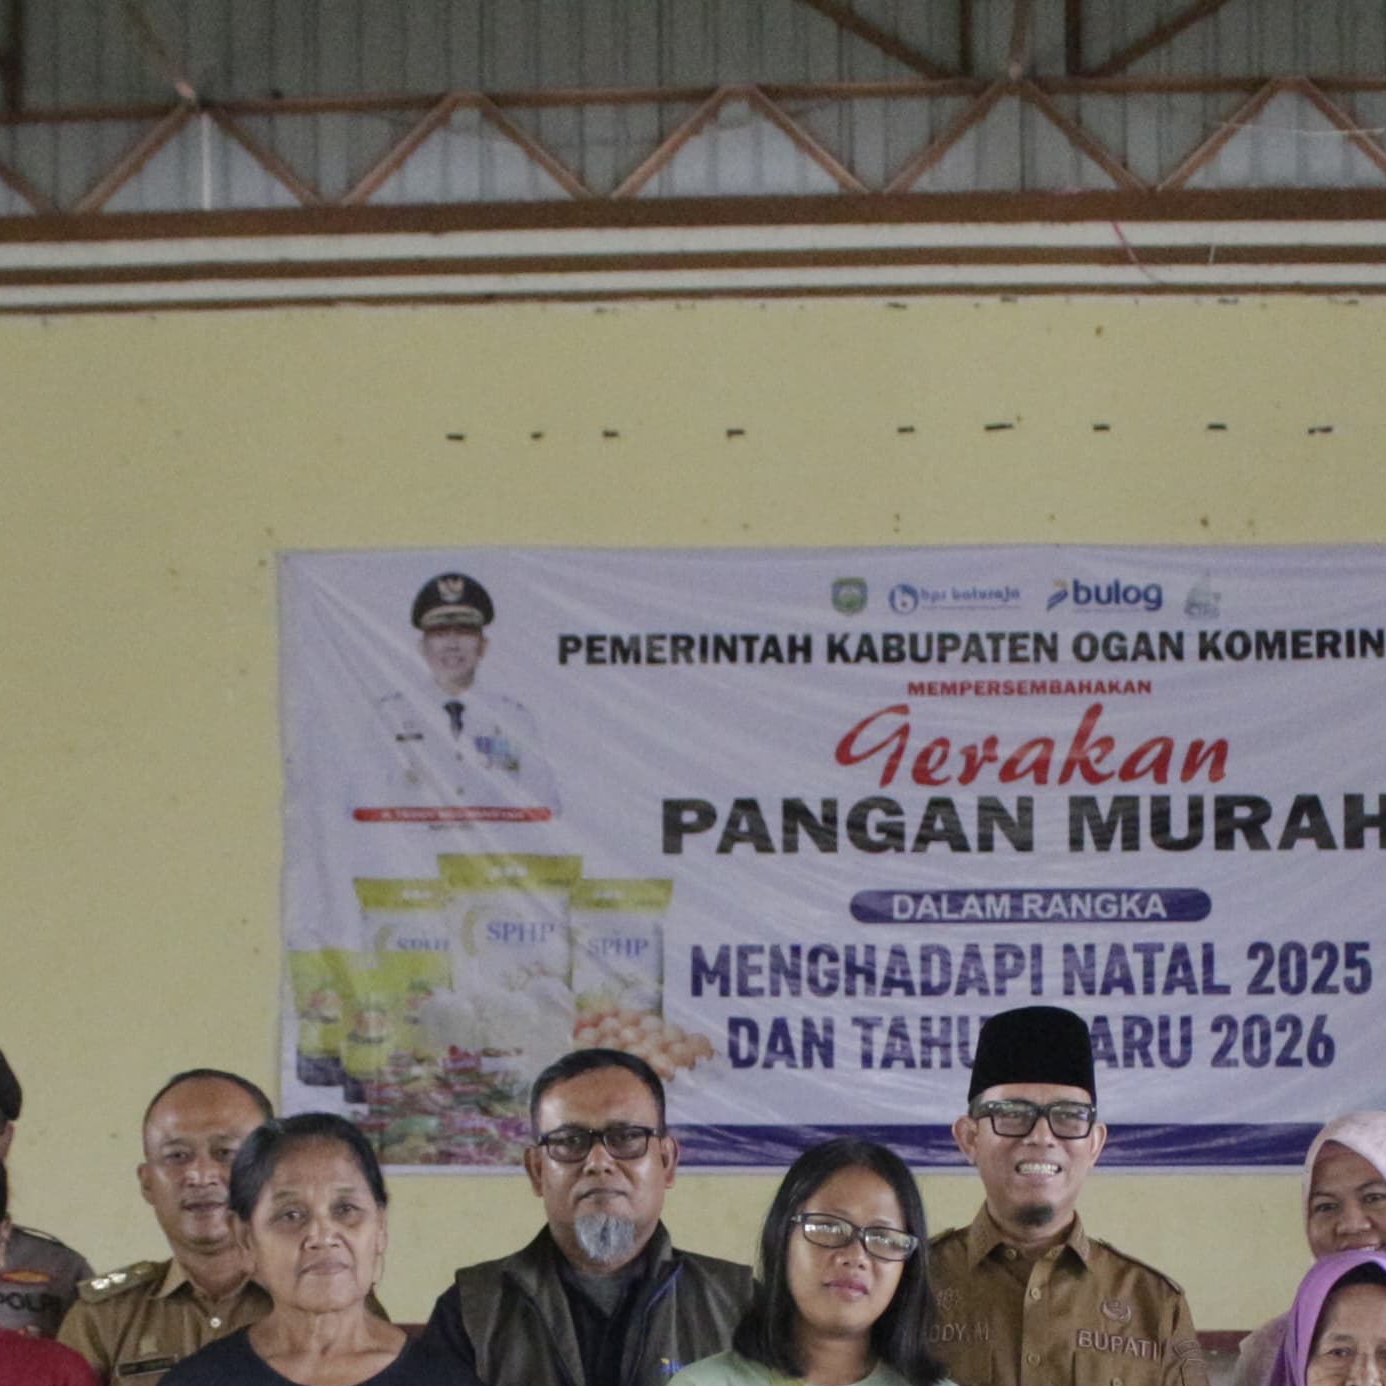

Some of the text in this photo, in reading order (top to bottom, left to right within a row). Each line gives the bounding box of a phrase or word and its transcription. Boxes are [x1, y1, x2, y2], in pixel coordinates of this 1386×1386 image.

[1073, 580, 1162, 611] bulog
[558, 634, 812, 665] PEMERINTAH
[827, 632, 1058, 663] KABUPATEN
[1072, 631, 1184, 661] OGAN
[907, 680, 1151, 697] MEMPERSEMBAHAKAN
[834, 703, 1229, 787] Gerakan
[662, 797, 1034, 854] PANGAN
[892, 894, 1167, 921] DALAM RANGKA
[486, 921, 555, 944] SPHP
[587, 937, 649, 957] SPHP
[690, 941, 1373, 998] MENGHADAPI NATAL 2025
[728, 1013, 1336, 1070] DAN TAHU ARU 2026
[1078, 1328, 1158, 1361] BUPATI
